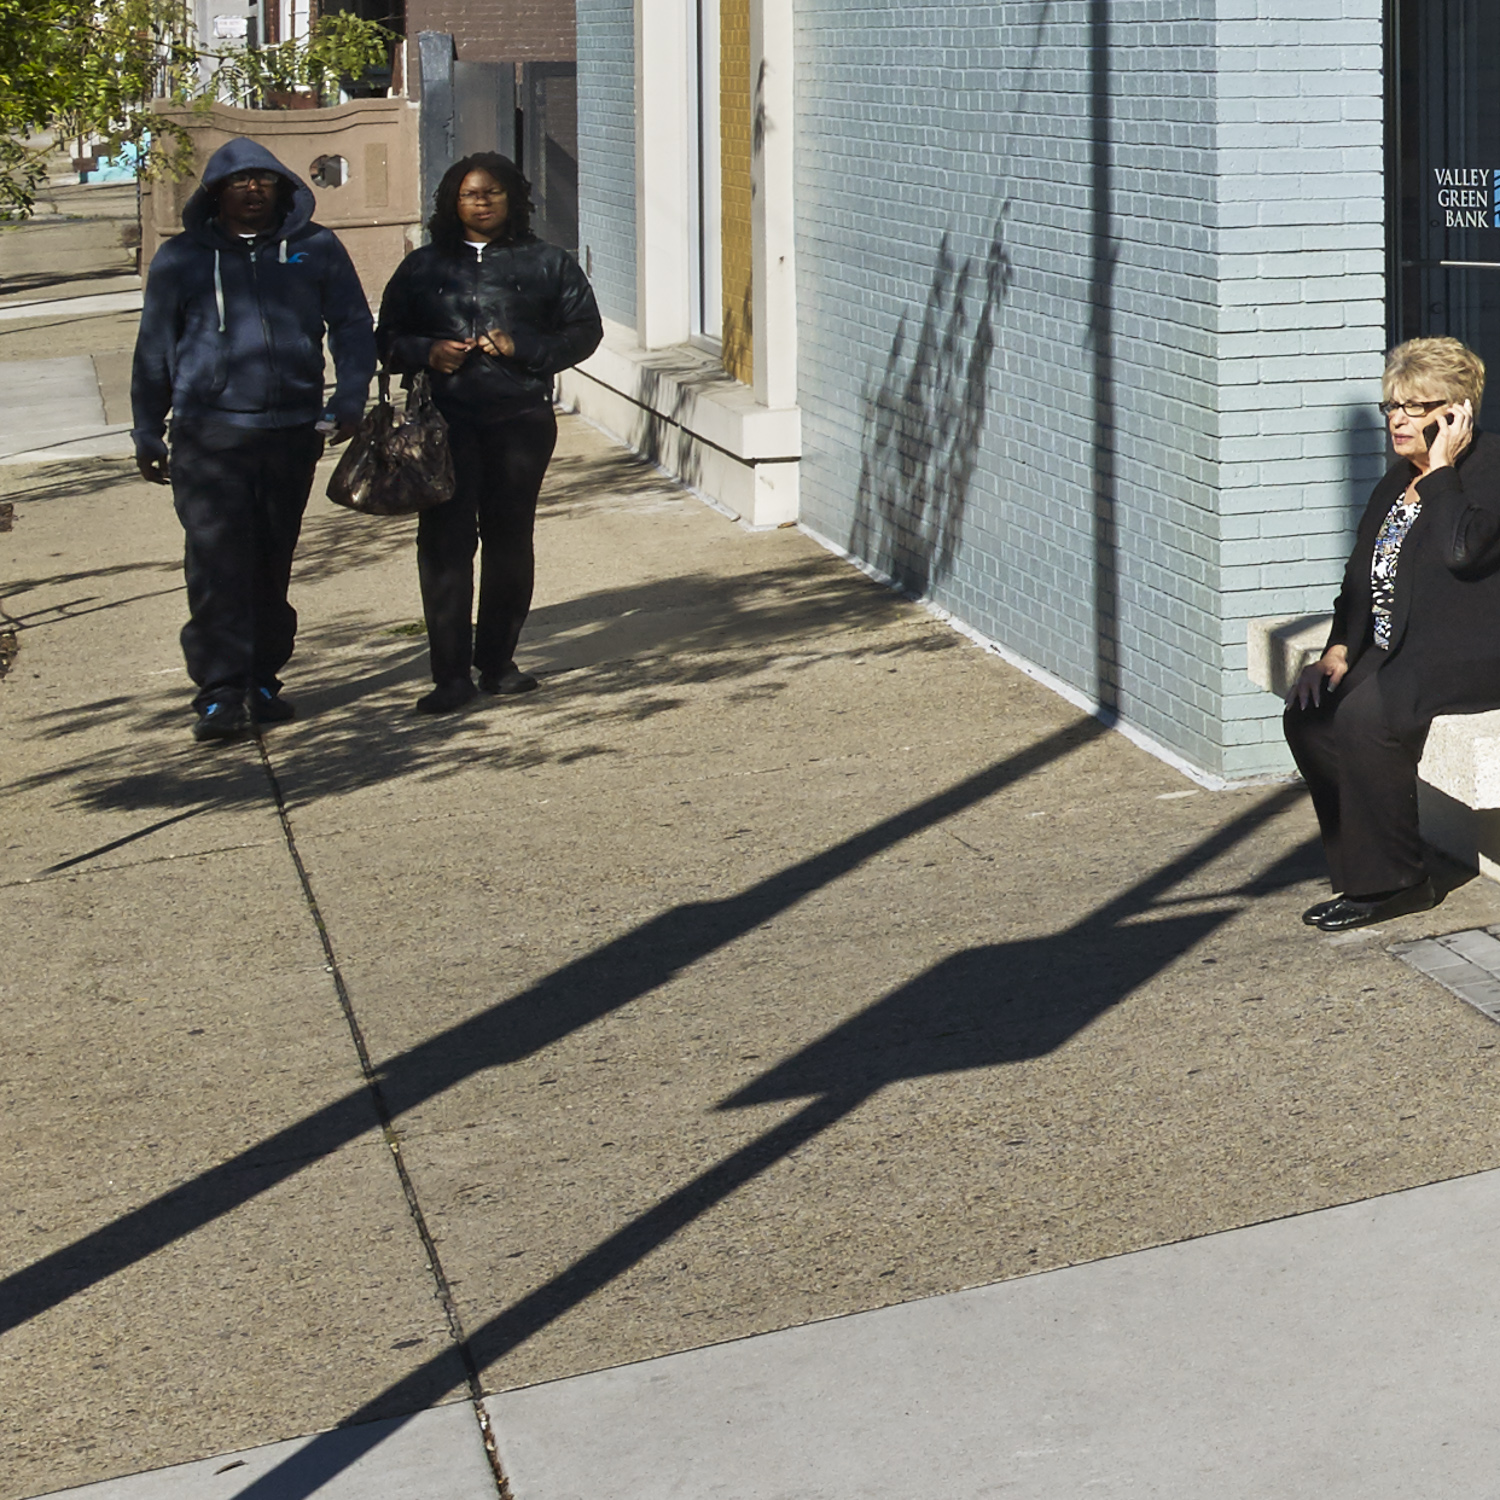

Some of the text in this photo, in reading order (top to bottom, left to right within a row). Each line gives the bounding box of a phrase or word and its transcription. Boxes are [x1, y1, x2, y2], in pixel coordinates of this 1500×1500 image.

[1434, 168, 1490, 187] VALLEY
[1438, 189, 1488, 208] GREEN
[1445, 210, 1489, 229] BANK
